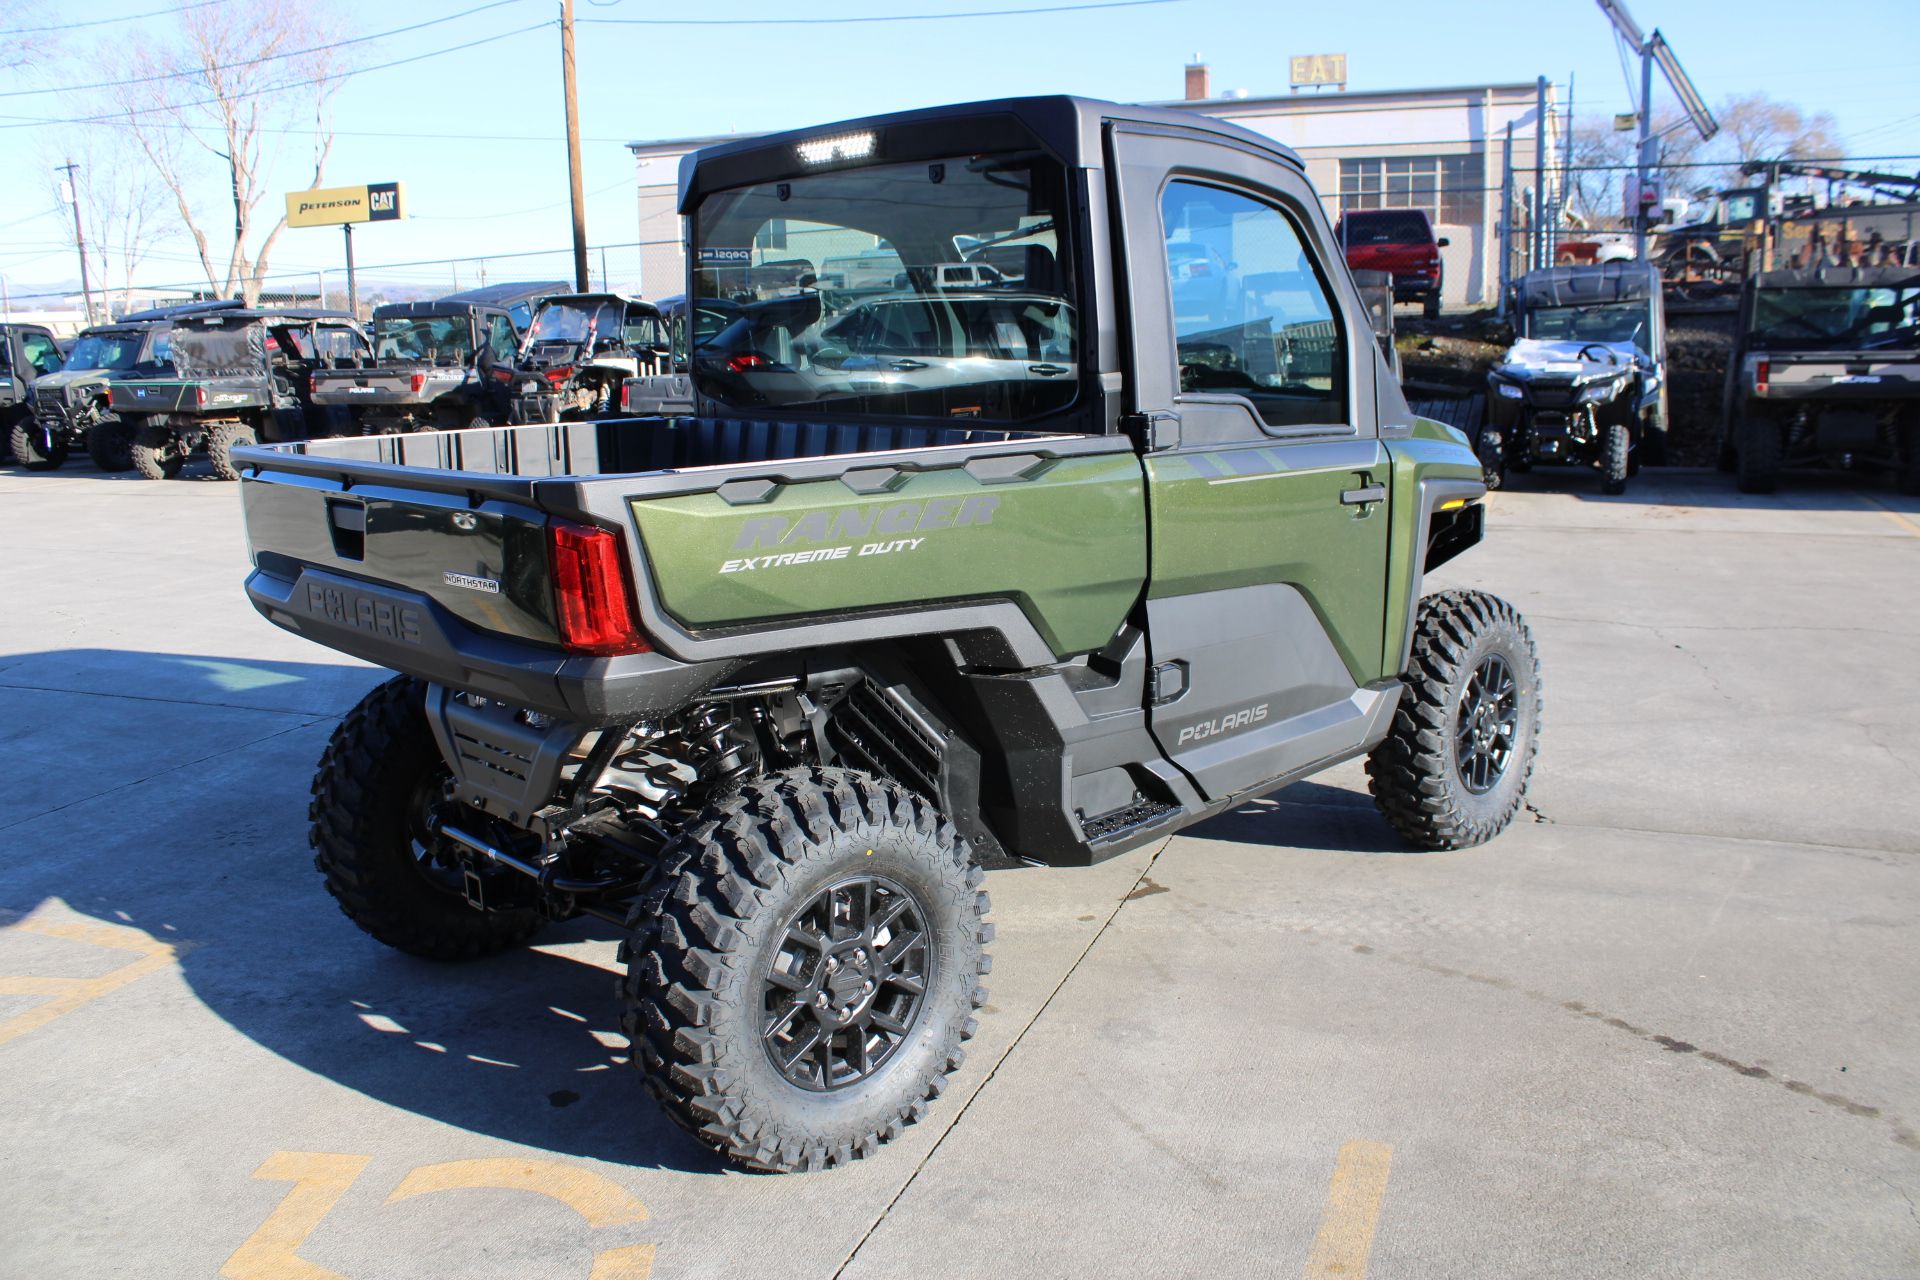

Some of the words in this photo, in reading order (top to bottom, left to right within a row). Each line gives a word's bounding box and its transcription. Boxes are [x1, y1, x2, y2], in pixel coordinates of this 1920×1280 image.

[1292, 55, 1344, 82] EAT
[299, 199, 361, 214] PETERSON
[370, 191, 396, 211] CAT
[731, 496, 999, 550] RANGER
[718, 546, 852, 574] EXTREME
[857, 537, 926, 557] DUTY
[445, 573, 497, 592] NORTHSTAR
[306, 582, 422, 645] POLARIS
[1177, 703, 1269, 746] POLARIS
